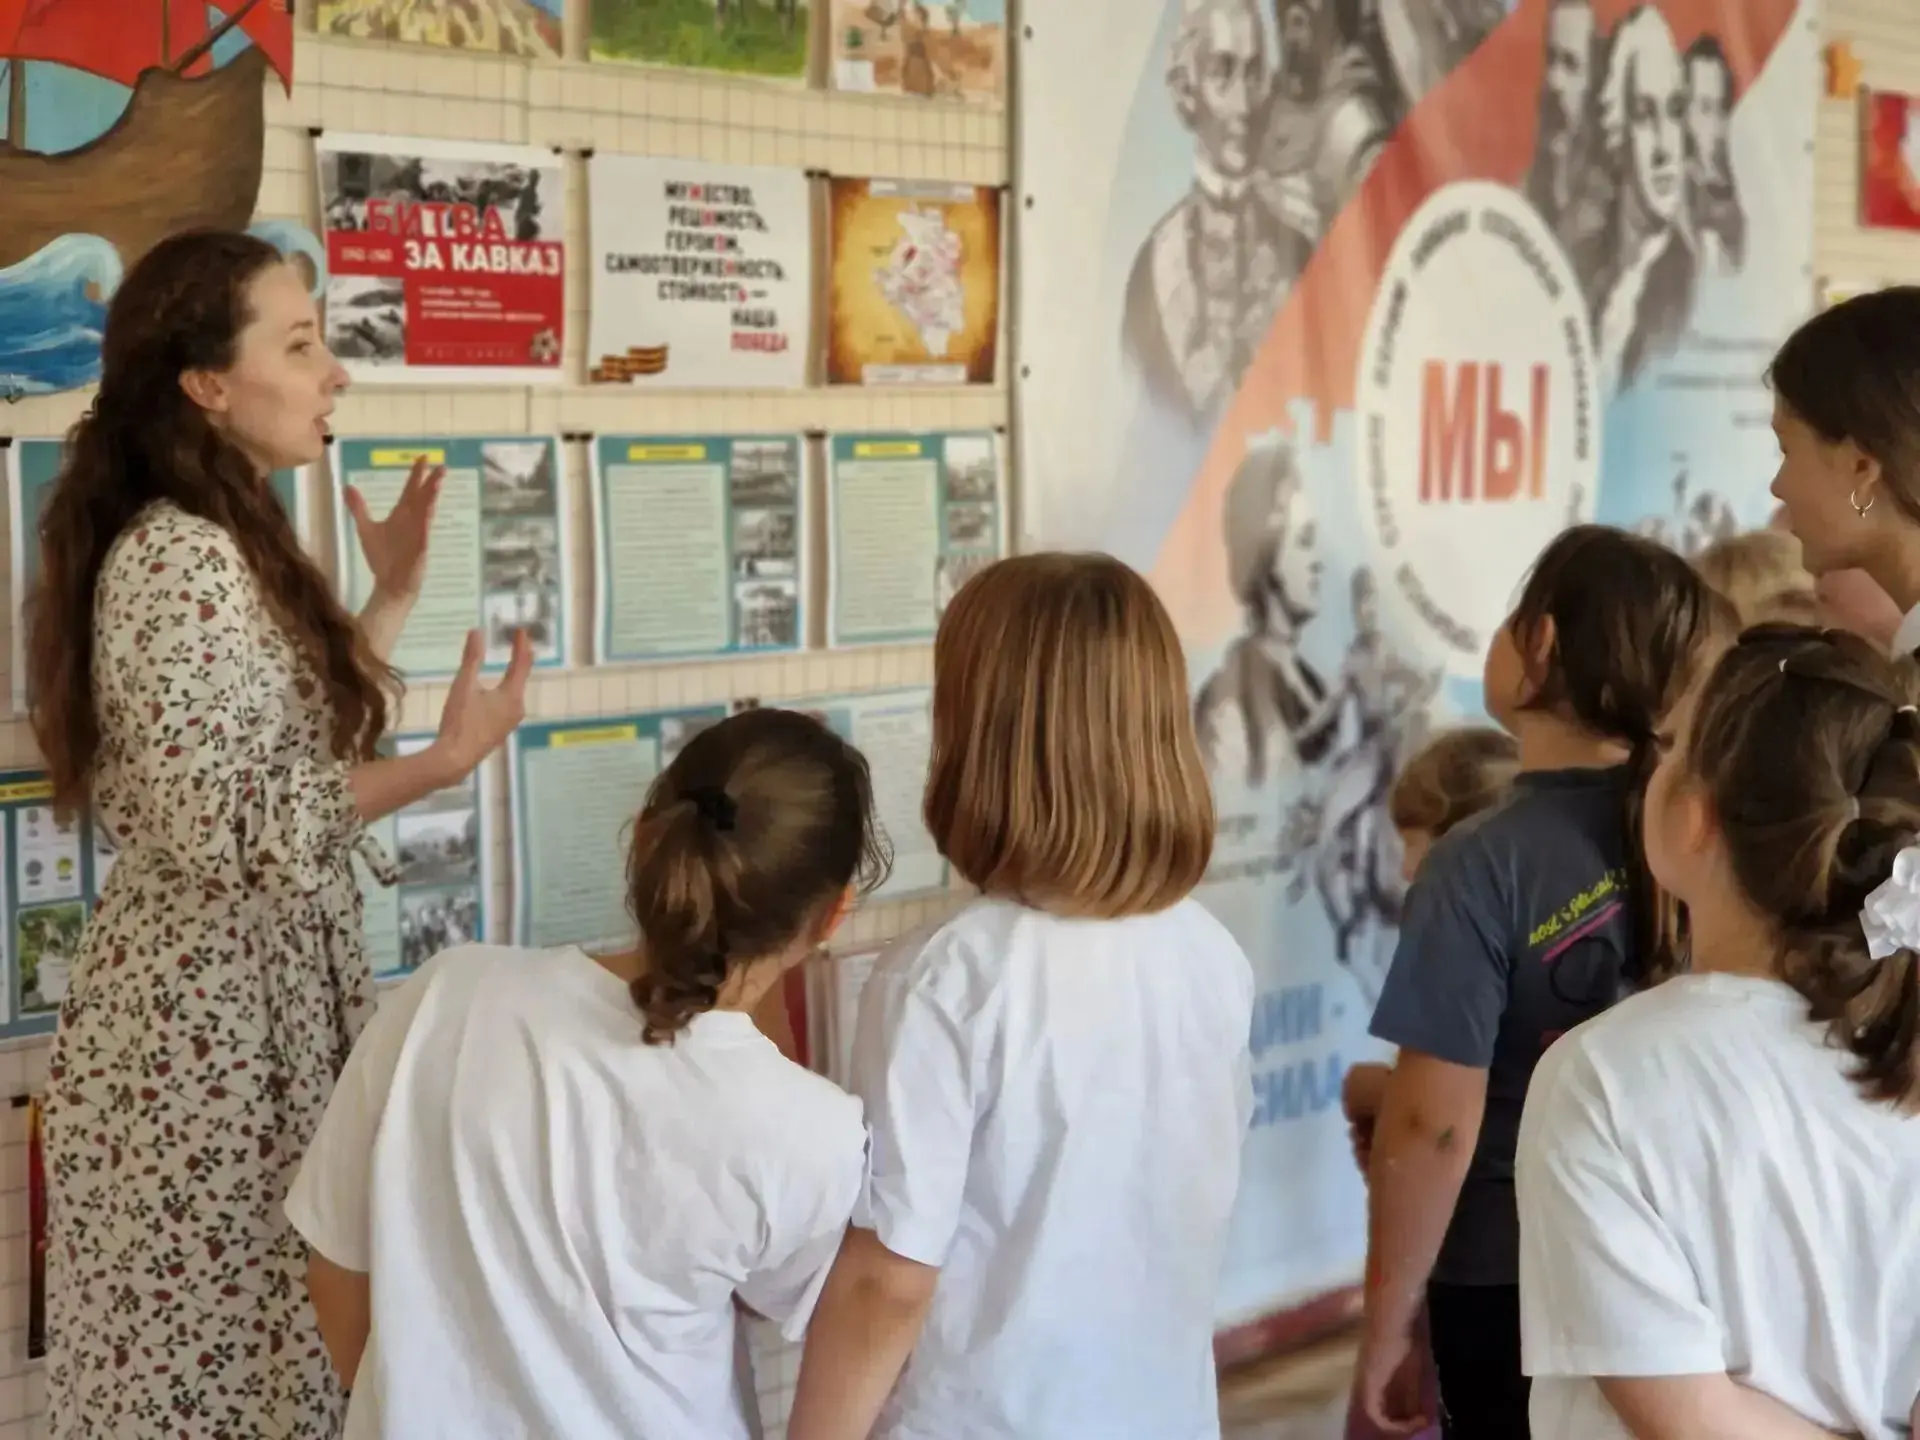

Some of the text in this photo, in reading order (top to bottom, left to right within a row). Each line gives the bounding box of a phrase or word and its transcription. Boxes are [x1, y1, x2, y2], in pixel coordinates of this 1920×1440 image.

[365, 198, 513, 241] БИТВА
[404, 240, 561, 276] ЗА КАВКАЗ
[1418, 358, 1550, 504] МЫ
